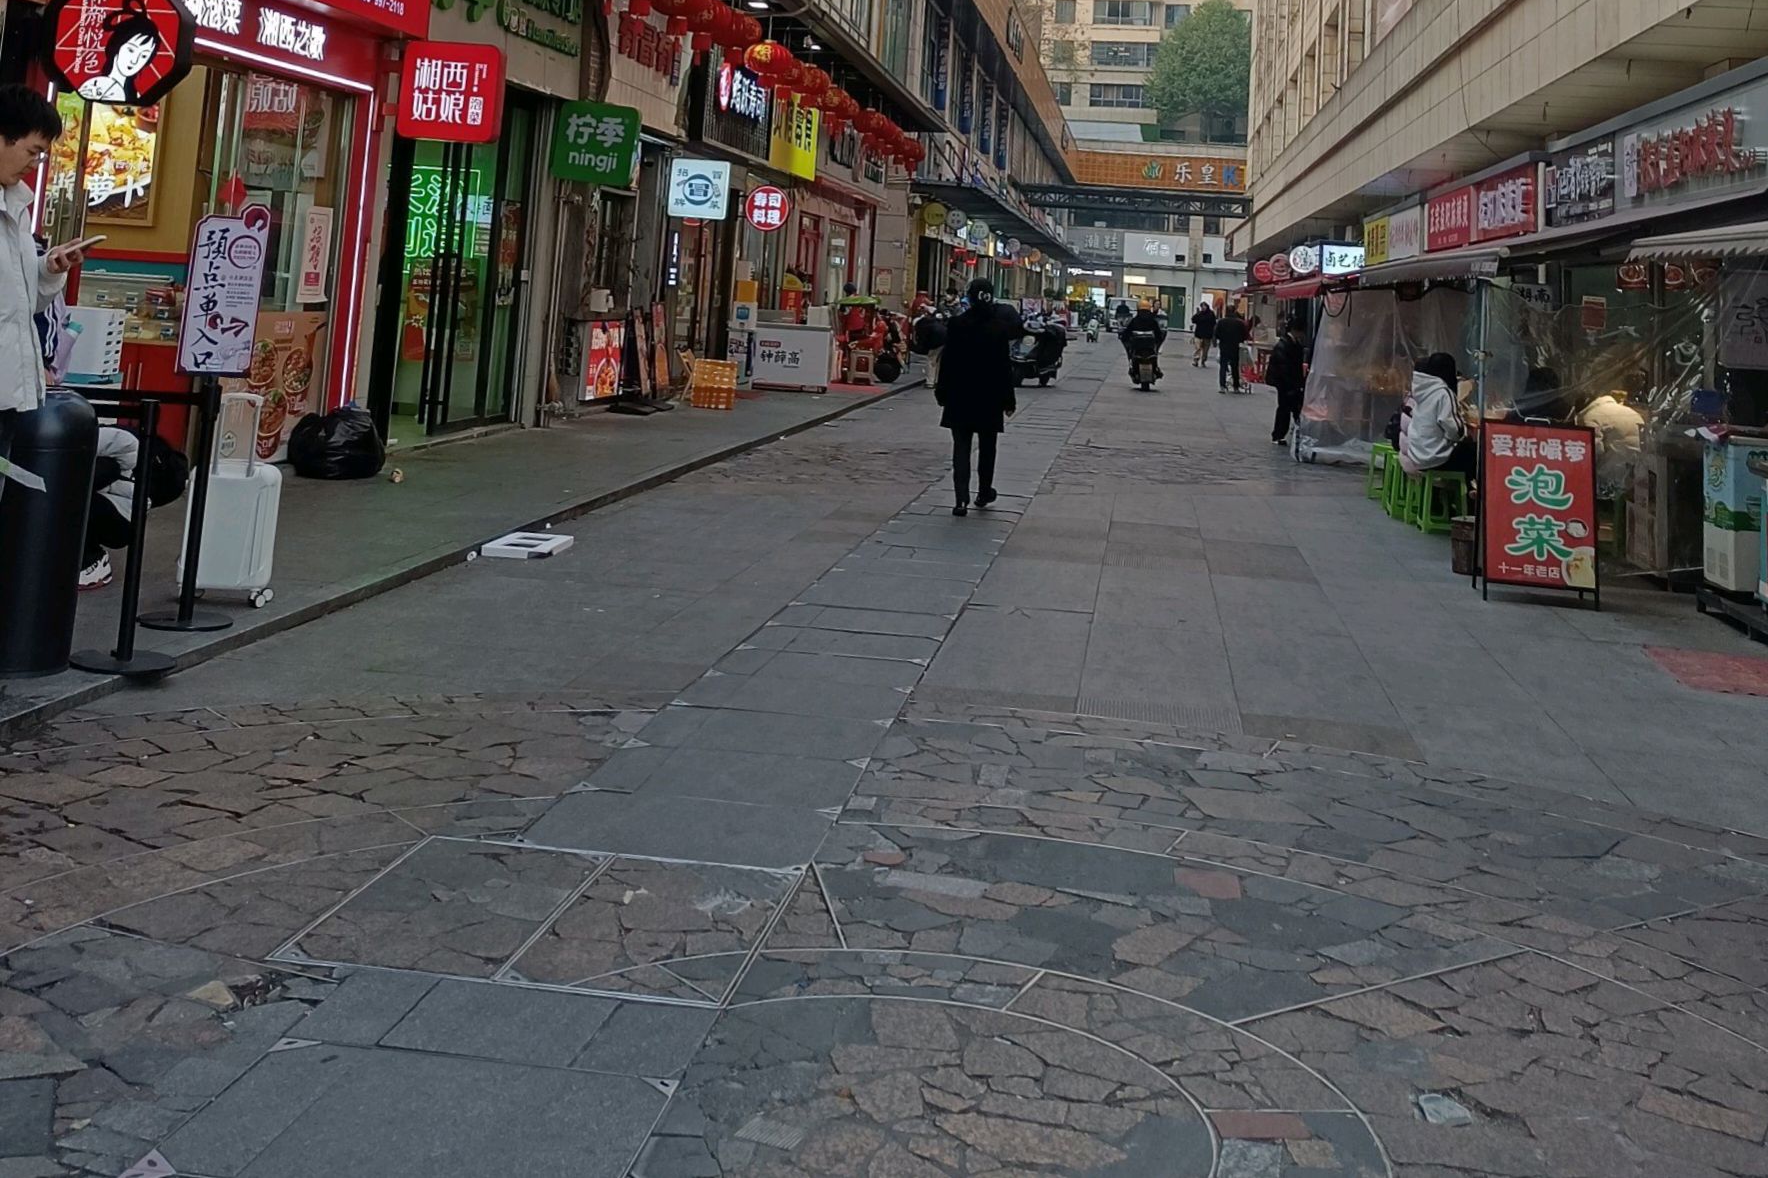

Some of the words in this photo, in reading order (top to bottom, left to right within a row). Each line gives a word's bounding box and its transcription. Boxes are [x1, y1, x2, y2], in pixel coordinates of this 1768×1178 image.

[413, 56, 469, 92] 湘西
[410, 89, 465, 124] 姑娘
[468, 98, 484, 125] 泡菜
[565, 113, 626, 148] 柠季
[567, 148, 619, 174] ningji
[753, 192, 783, 208] 寿司
[752, 207, 782, 225] 料理
[760, 349, 801, 365] 钟薛高
[1491, 434, 1586, 462] 爱新嚼萝
[1504, 463, 1574, 561] 泡菜
[1498, 561, 1561, 579] 十一年老店
